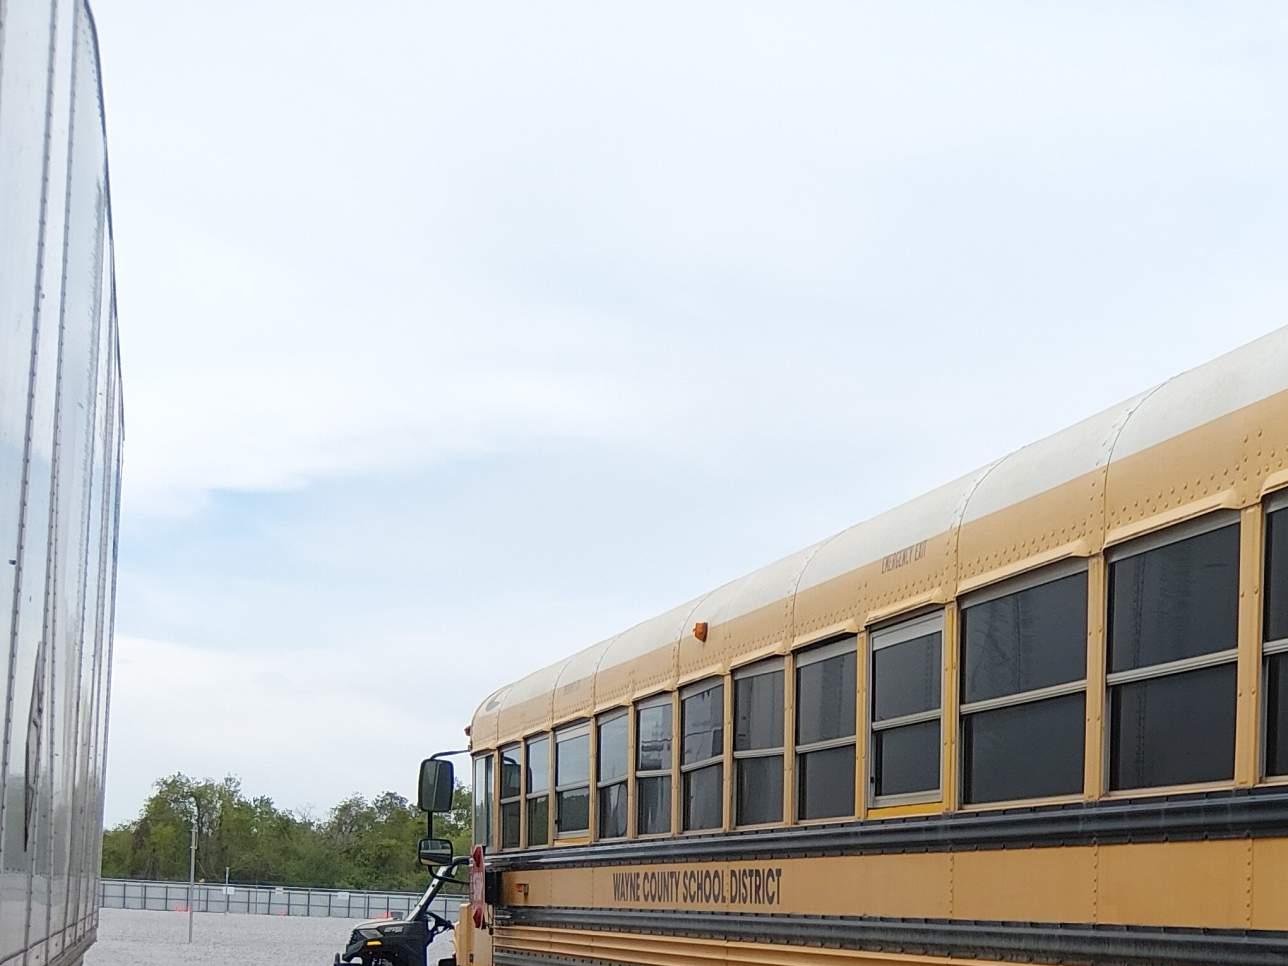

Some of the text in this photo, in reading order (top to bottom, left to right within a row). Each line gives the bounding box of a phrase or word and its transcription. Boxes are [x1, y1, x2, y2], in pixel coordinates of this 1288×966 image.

[613, 867, 782, 905] WAYNE COUNTY SCHOOL DISTRICT
